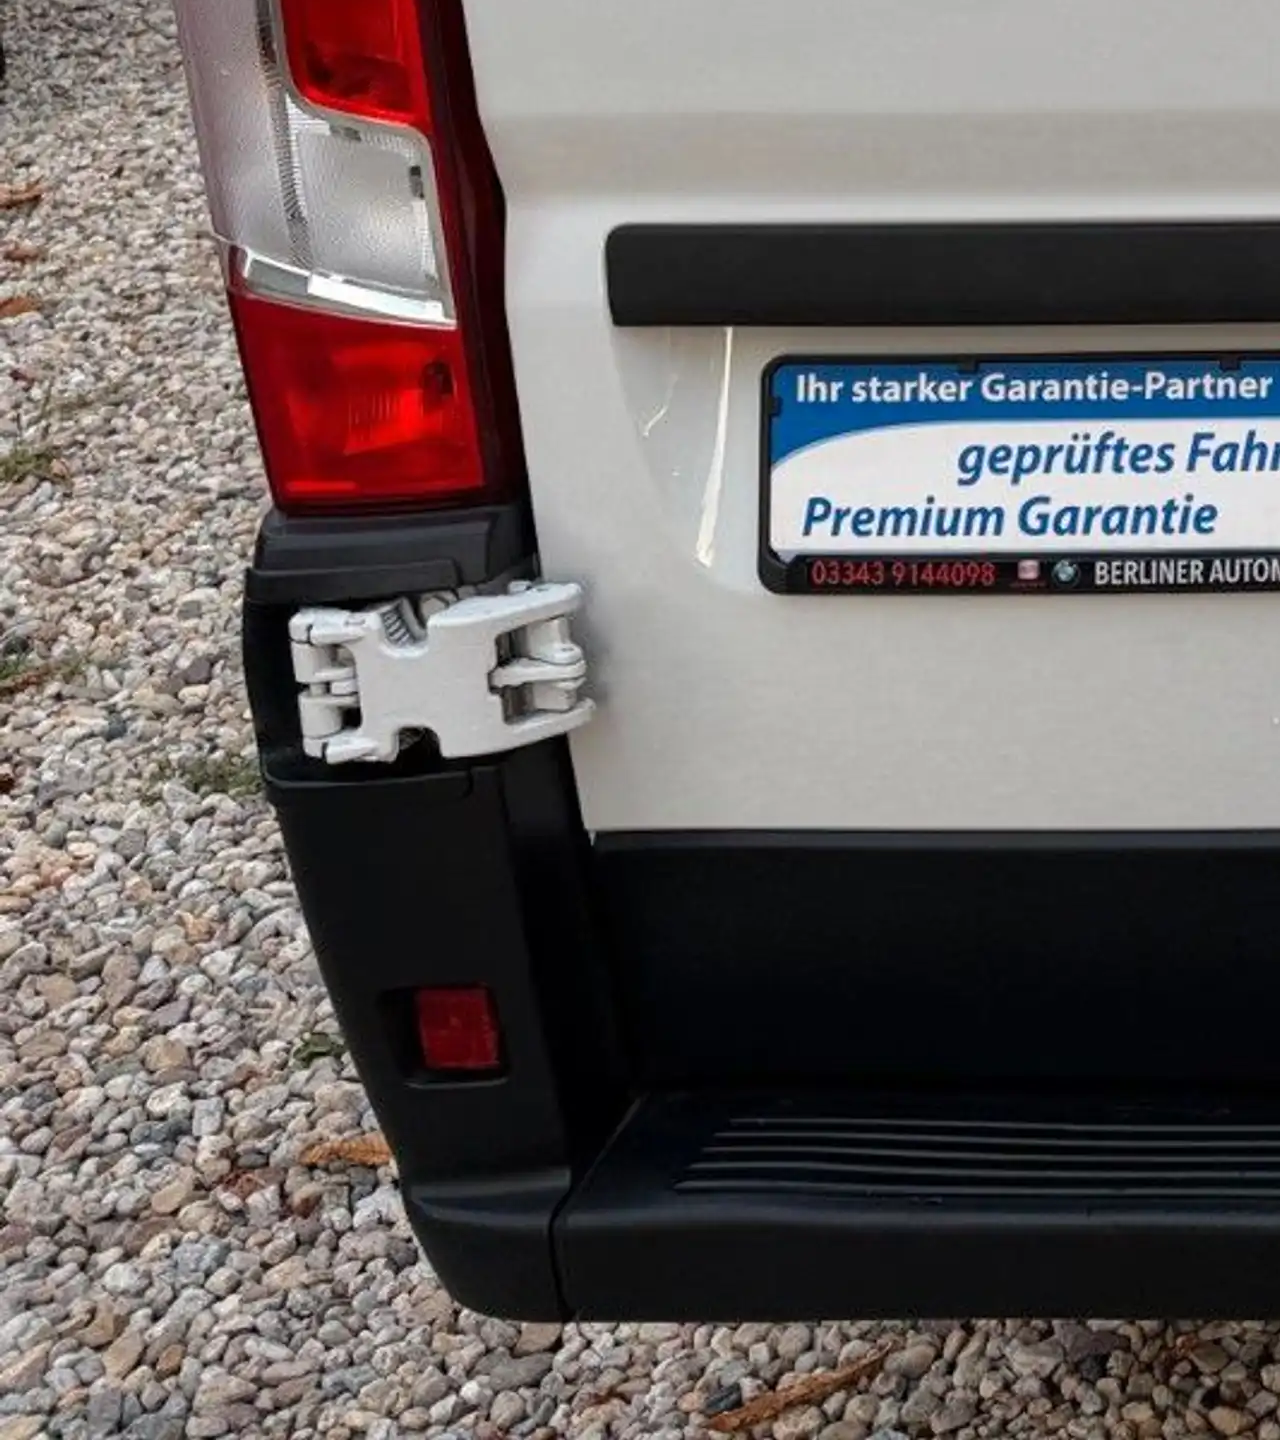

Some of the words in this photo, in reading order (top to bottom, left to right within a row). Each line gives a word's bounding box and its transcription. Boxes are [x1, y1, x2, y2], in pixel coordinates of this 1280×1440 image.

[797, 374, 843, 403] Ihr
[852, 372, 974, 403] starker
[981, 370, 1273, 401] Garantie-Partner
[957, 432, 1175, 486] geprüftes
[802, 495, 1006, 538] Premium
[1018, 493, 1219, 537] Garantie
[812, 560, 886, 586] 03343
[891, 560, 996, 587] 9144098
[1094, 560, 1203, 585] BERLINER
